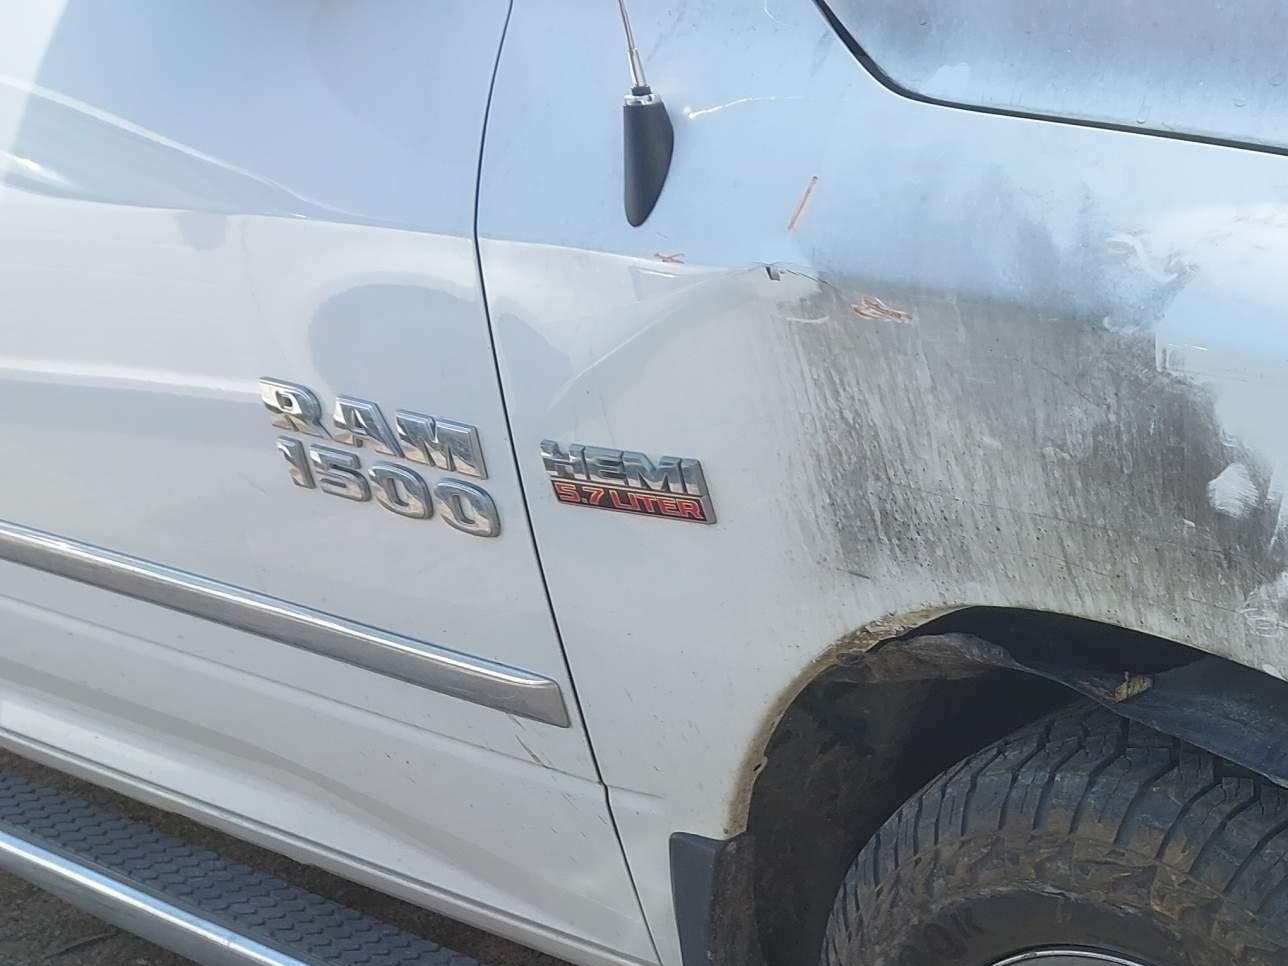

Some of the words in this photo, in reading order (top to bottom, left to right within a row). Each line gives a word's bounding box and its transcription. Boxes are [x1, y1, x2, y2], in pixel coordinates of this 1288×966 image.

[260, 376, 488, 481] RAM
[540, 439, 705, 496] HEMI
[275, 436, 502, 538] 1500
[554, 482, 607, 507] 5.7
[610, 490, 706, 520] LITER
